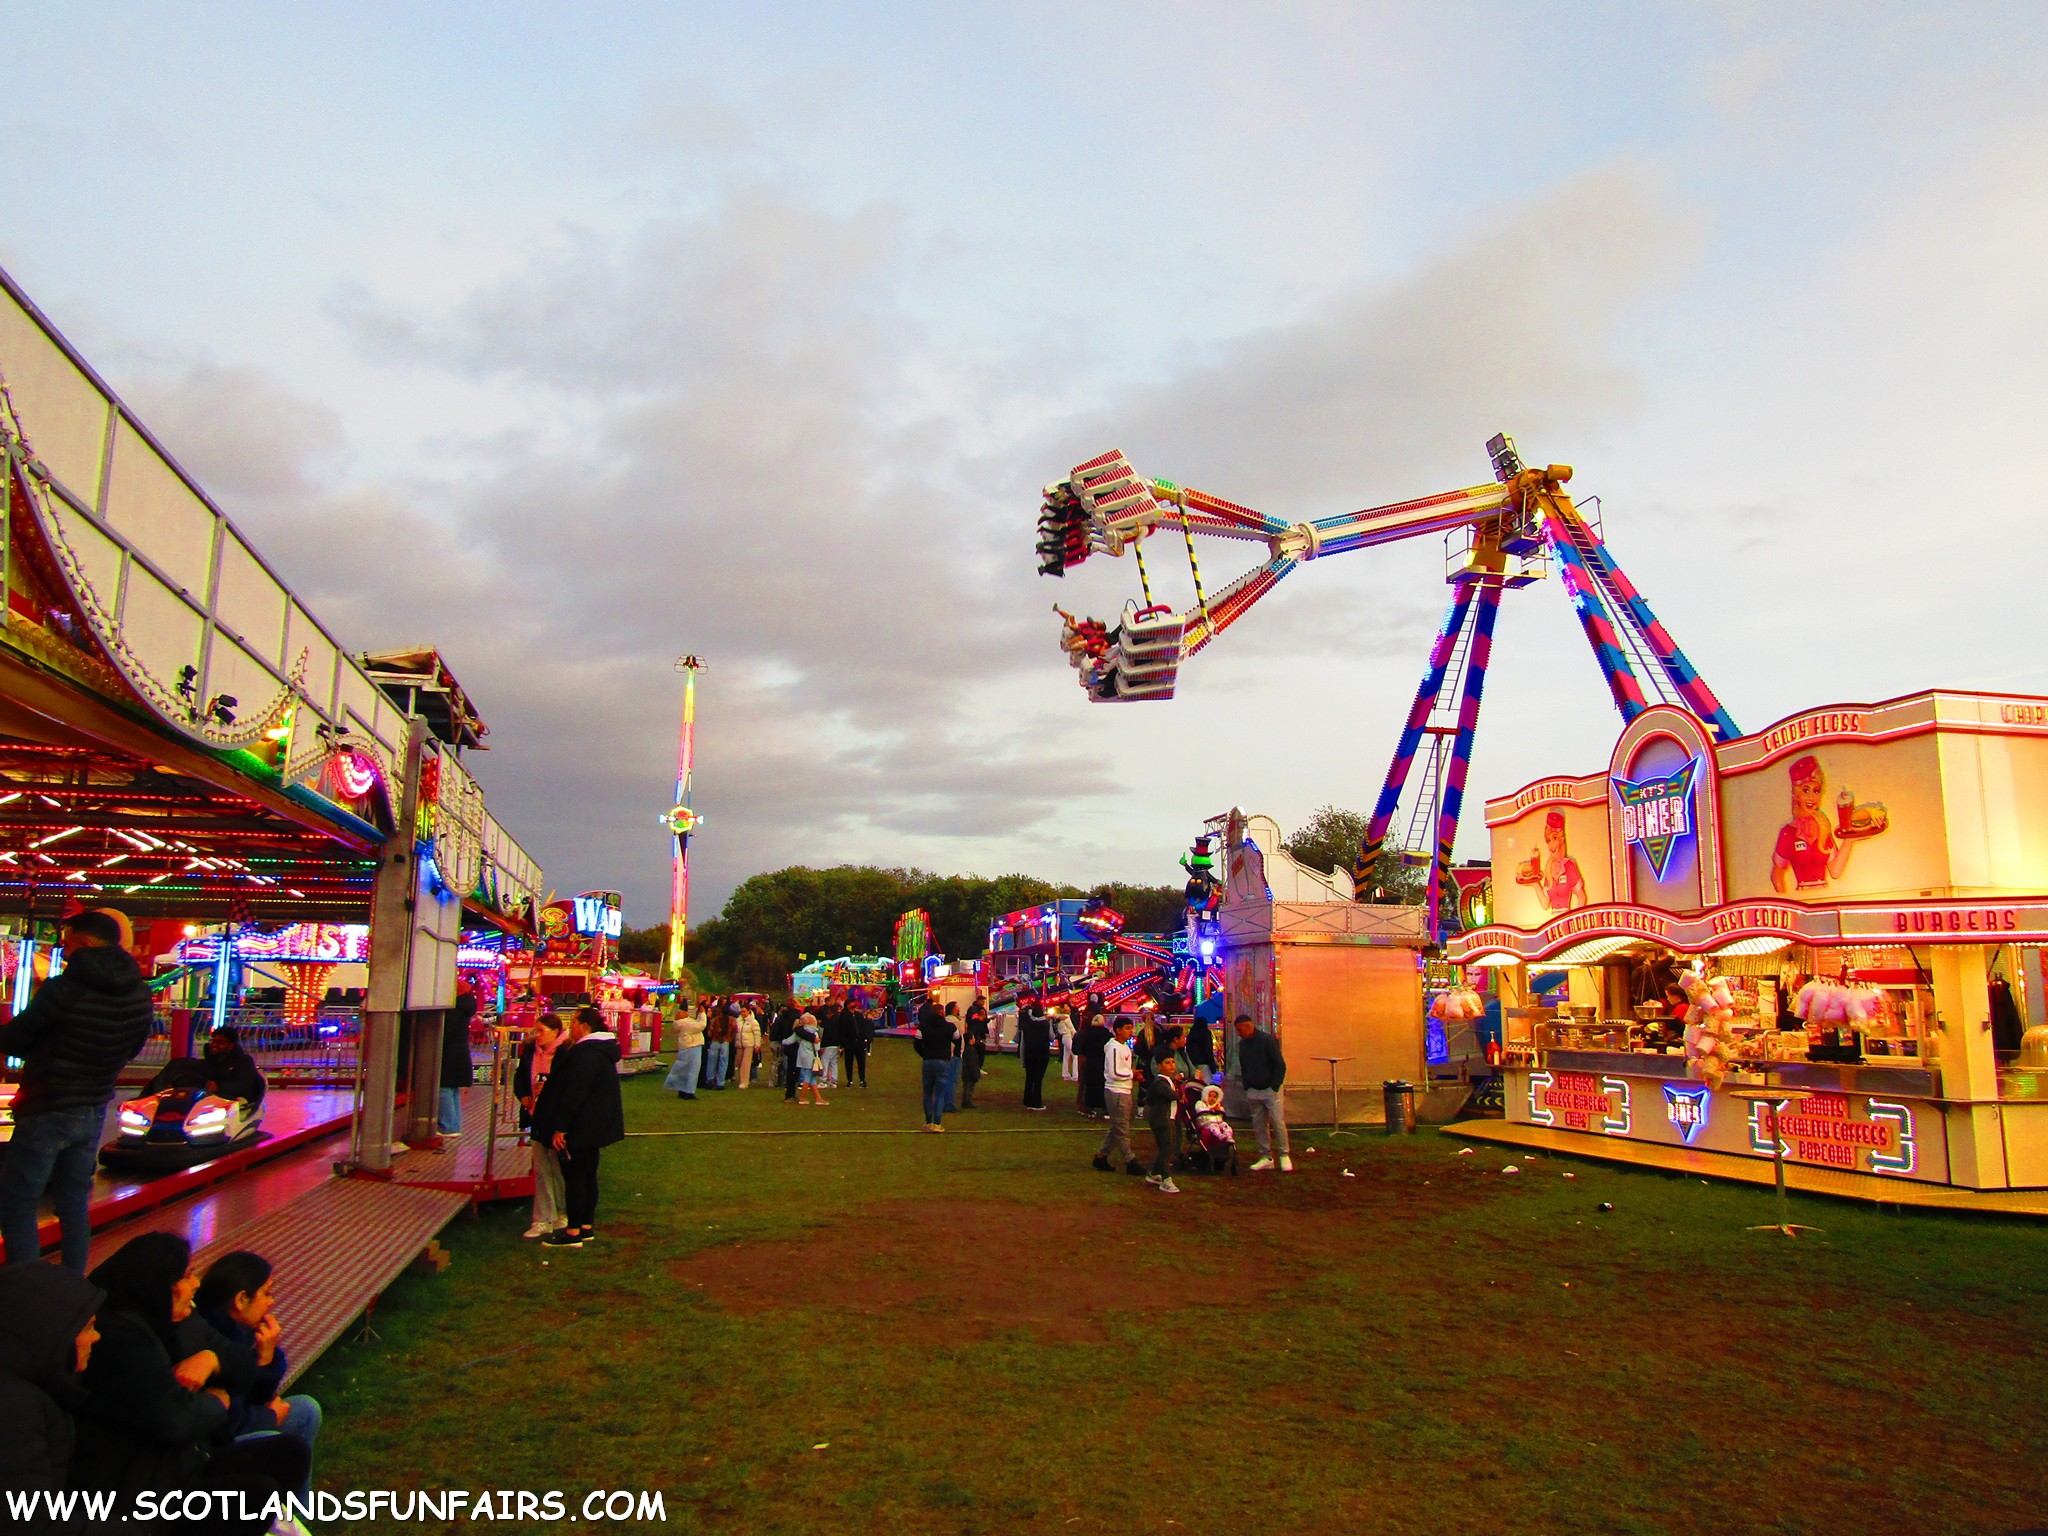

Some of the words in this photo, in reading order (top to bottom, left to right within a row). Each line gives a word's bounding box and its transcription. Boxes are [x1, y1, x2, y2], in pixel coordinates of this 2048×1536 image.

[1763, 720, 1806, 752] CANDY
[1813, 714, 1859, 734] FLOSS
[1515, 789, 1537, 810] COLD
[1540, 784, 1574, 799] DRINKS
[1640, 784, 1665, 799] KT'S
[1624, 796, 1686, 843] DINER
[1467, 932, 1500, 950] ALWAYS
[1504, 934, 1514, 948] IN
[1546, 923, 1564, 944] THE
[1568, 914, 1597, 936] MOOD
[1601, 911, 1623, 927] FOR
[1627, 913, 1666, 935] GREAT
[1713, 910, 1748, 934] FAST
[1754, 907, 1791, 929] FOOD
[1895, 909, 2017, 933] BURGERS
[1801, 1097, 1845, 1117] DONUTS
[1766, 1115, 1831, 1140] SECIALITY
[1834, 1121, 1888, 1146] COFFEES
[1799, 1140, 1853, 1166] POPCORN
